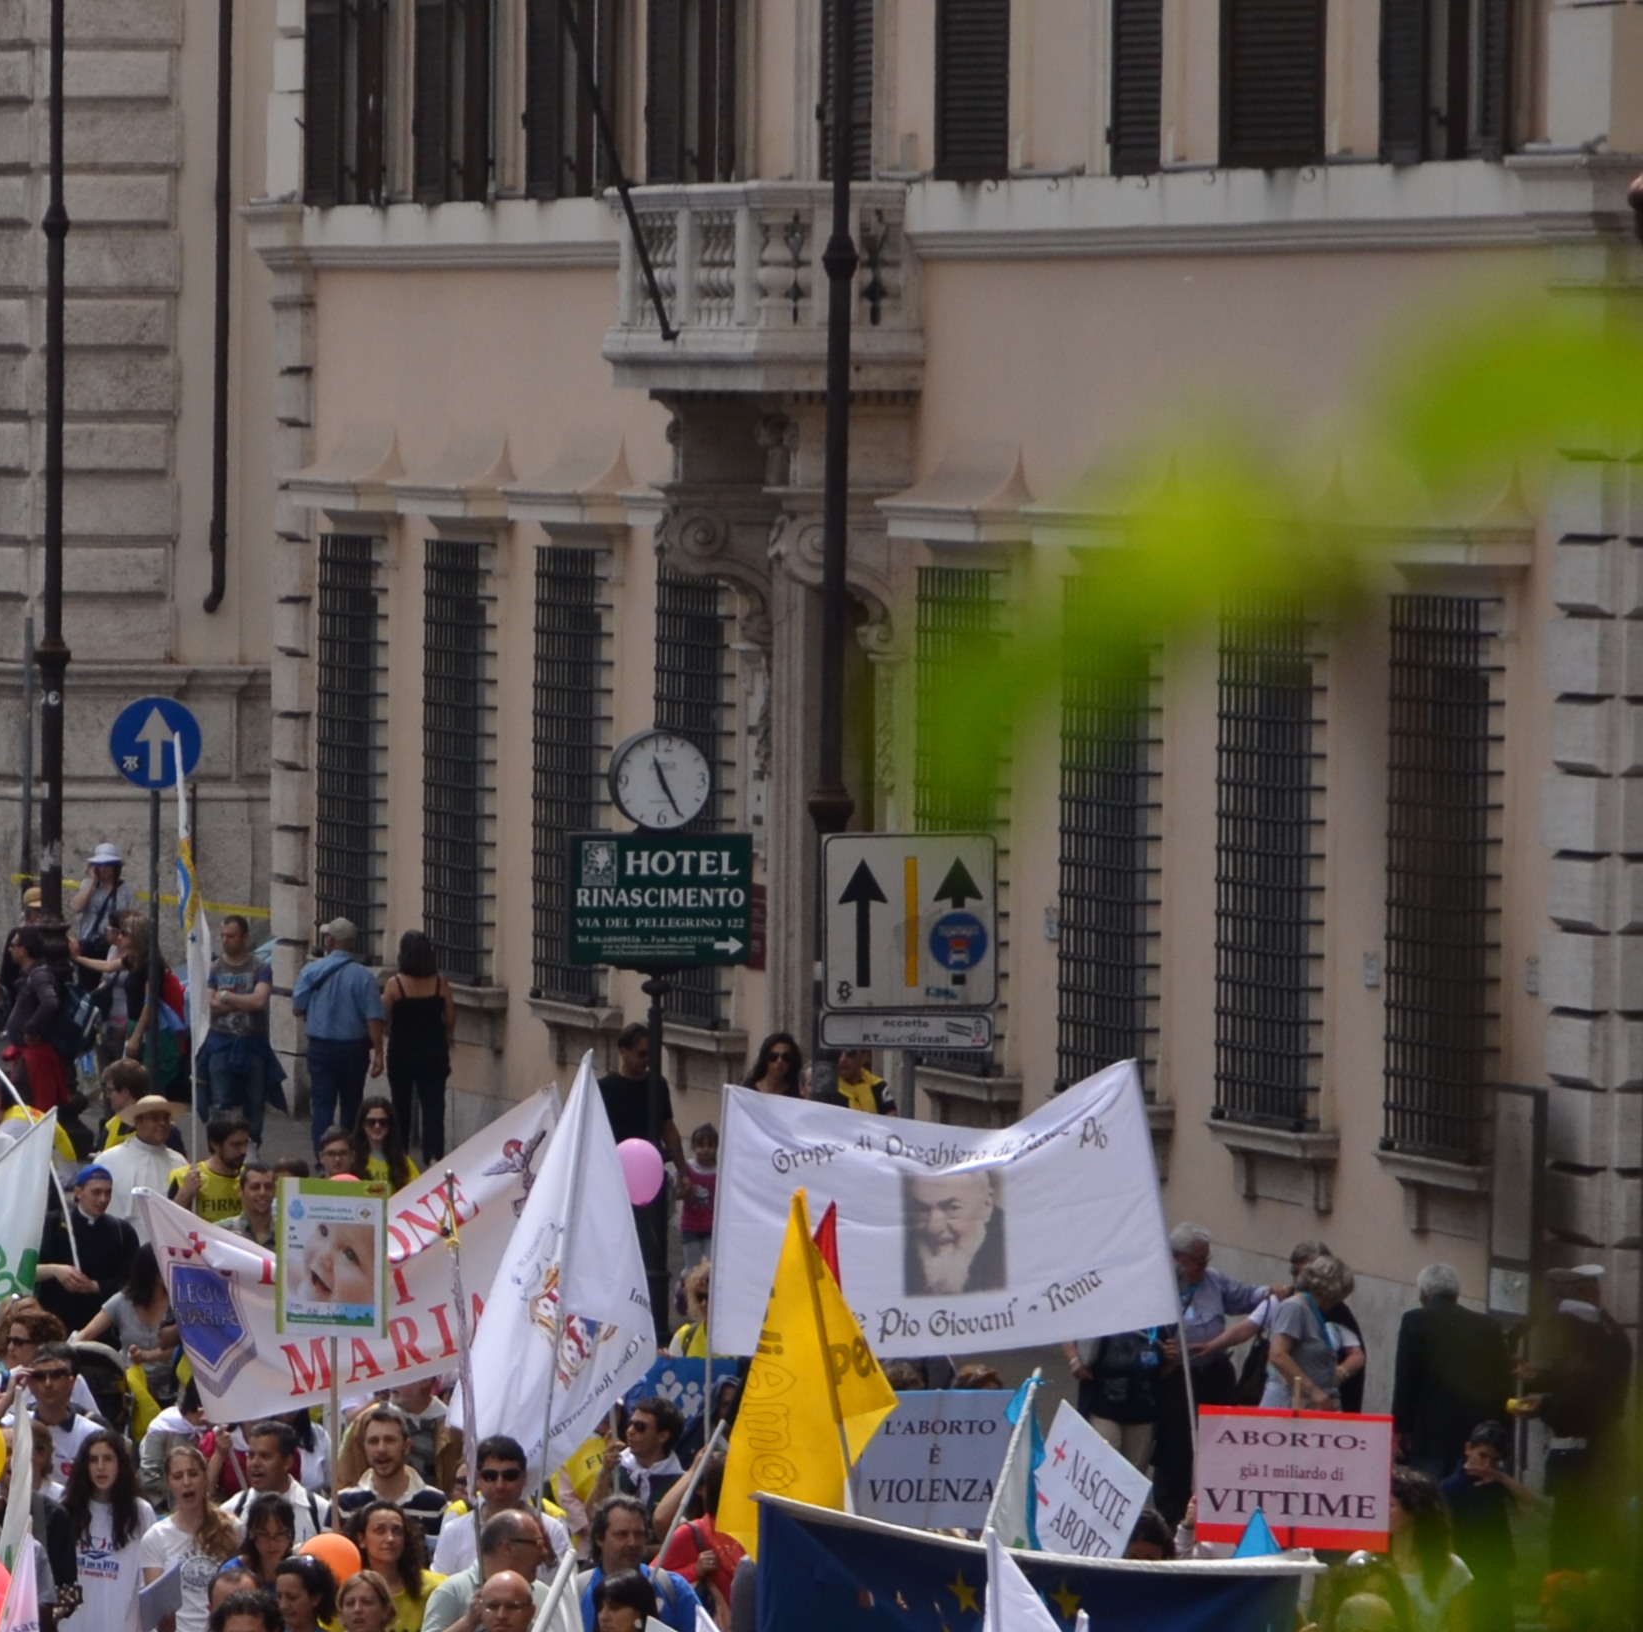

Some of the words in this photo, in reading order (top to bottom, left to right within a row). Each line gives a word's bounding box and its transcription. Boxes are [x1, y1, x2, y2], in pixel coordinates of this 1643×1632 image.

[654, 736, 673, 753] 12
[618, 774, 630, 791] 9
[697, 772, 707, 789] 3
[657, 808, 667, 825] 6
[625, 851, 740, 876] HOTEL
[576, 888, 746, 908] RINASCIMENTO
[576, 918, 601, 928] VIA
[605, 918, 631, 928] DEL
[635, 918, 722, 928] PELLEGRINO
[882, 1018, 930, 1028] eccetto
[771, 1141, 846, 1175] Gruppo
[884, 1133, 988, 1169] Preghiera
[1078, 1116, 1109, 1151] Pio
[876, 1307, 921, 1344] Pio
[1041, 1268, 1104, 1315] Roma
[884, 1419, 997, 1436] L'ABORTO
[1216, 1429, 1368, 1451] ABORTO:
[928, 1443, 941, 1465] È
[1239, 1464, 1259, 1480] già
[1272, 1464, 1327, 1480] miliardo
[1330, 1467, 1344, 1481] di
[869, 1477, 997, 1504] VIOLENZA
[1064, 1448, 1132, 1532] NASCITE
[1203, 1487, 1377, 1520] VITTIME
[1048, 1504, 1113, 1559] ABORTI
